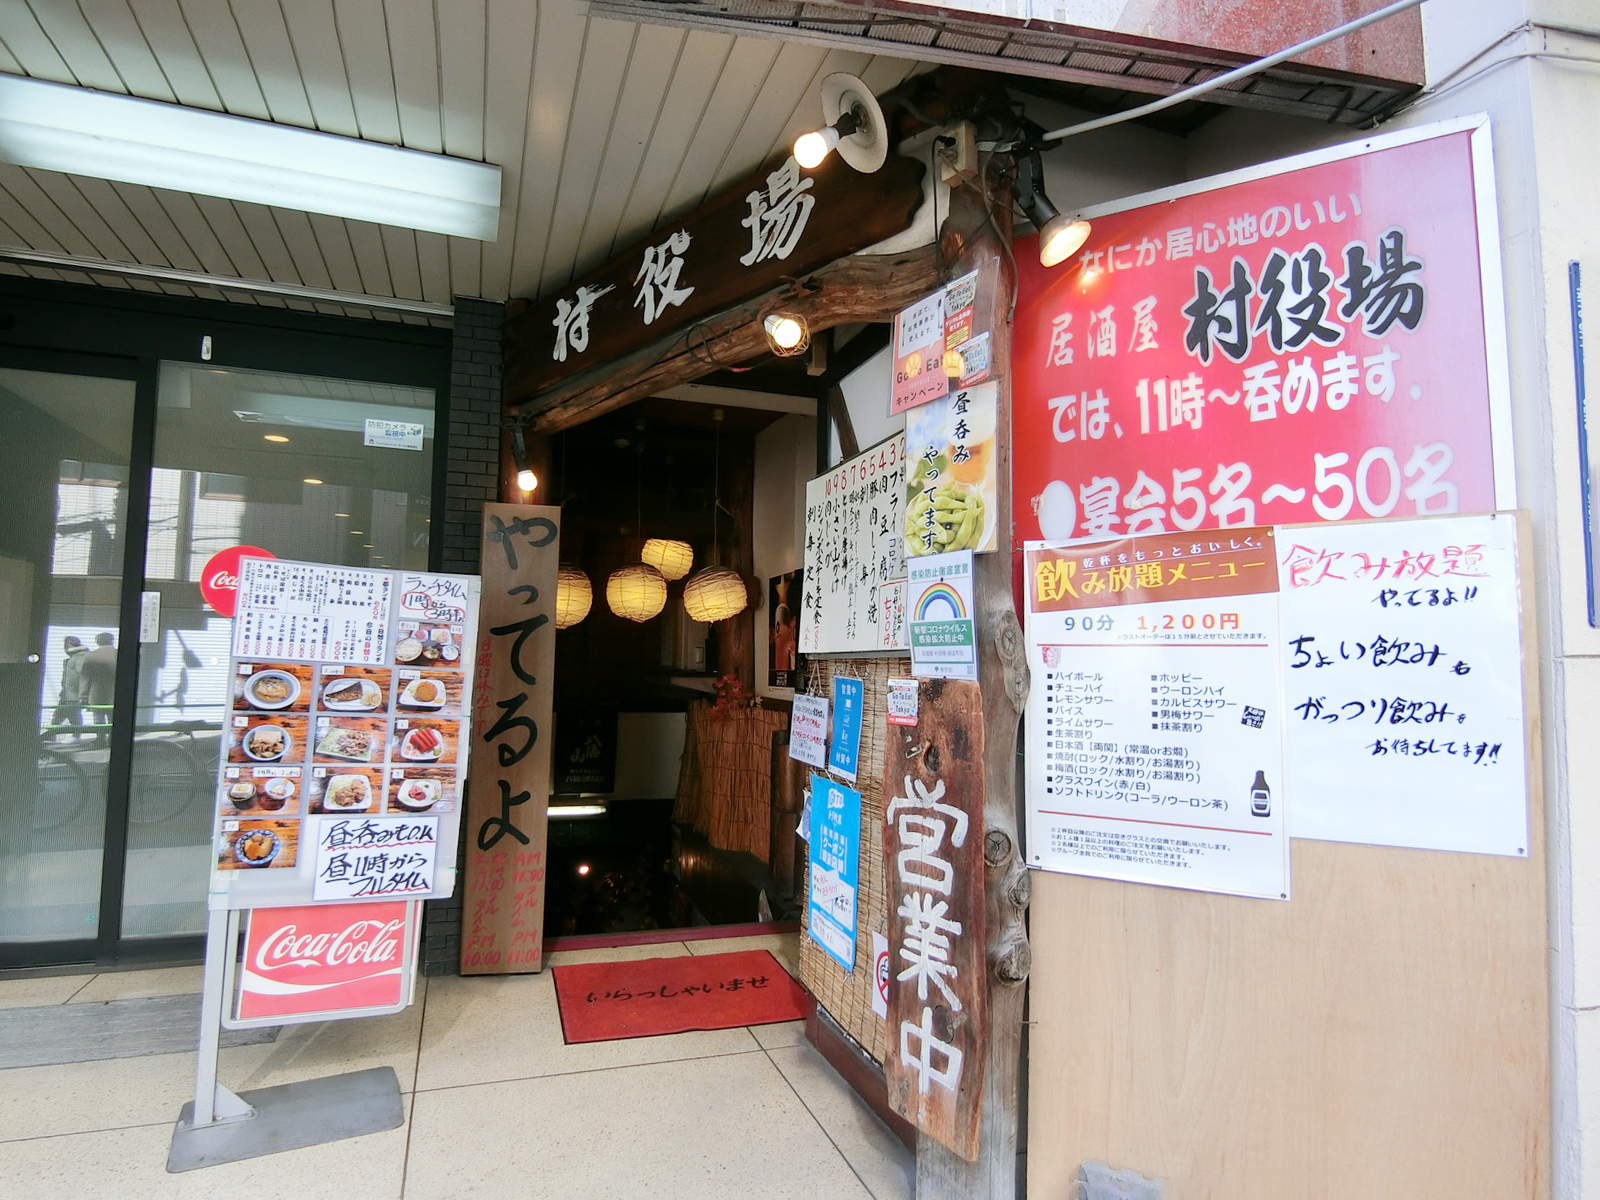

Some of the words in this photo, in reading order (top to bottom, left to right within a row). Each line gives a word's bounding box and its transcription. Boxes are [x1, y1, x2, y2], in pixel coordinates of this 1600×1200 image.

[1078, 192, 1363, 277] なにか居心地のいい
[552, 155, 816, 363] 村役場
[1045, 296, 1160, 369] 居酒屋
[1184, 227, 1425, 363] 村役場
[896, 382, 944, 406] キャンペーン
[368, 421, 406, 431] 防犯カメラ
[952, 391, 971, 465] 昼呑み
[824, 479, 831, 498] 10
[833, 474, 838, 494] 9
[841, 470, 847, 490] 8
[850, 465, 855, 485] 7
[860, 459, 866, 480] 6
[869, 454, 876, 476] 5
[879, 450, 887, 470] 4
[890, 443, 896, 466] 3
[879, 475, 889, 581] 肉豆腐
[1082, 537, 1262, 568] 乾杯をもっとおいしく。
[911, 563, 969, 580] 感染防止徹底宣言
[1282, 544, 1491, 589] 飲み放題
[405, 577, 467, 600] ランチタイム
[1034, 559, 1266, 602] 飲み放題メニュー
[403, 593, 447, 608] 11時から
[1372, 586, 1478, 608] やってるよ!!
[914, 624, 968, 634] 新型コロナウイルス
[1064, 614, 1114, 630] 90分
[1137, 613, 1241, 632] 1,200円
[1289, 634, 1471, 676] ちょい飲みも
[478, 515, 558, 851] やってるよ
[1055, 672, 1103, 682] ハイボール
[1160, 674, 1202, 683] ホッピー
[1055, 684, 1103, 693] チューハイ
[1160, 686, 1225, 696] ウーロンハイ
[895, 705, 909, 713] Tokyo
[1055, 695, 1114, 705] レモンサワー
[1160, 698, 1237, 708] カルピスサワー
[1294, 696, 1467, 725] がっつり飲みも
[1055, 706, 1084, 716] バイス
[1160, 710, 1214, 720] 男梅サワー
[1055, 718, 1114, 728] ライムサワー
[1160, 722, 1203, 733] 抹茶割り
[1055, 729, 1093, 740] 生茶割り
[1366, 738, 1503, 767] お待ちしてます!!
[1055, 774, 1151, 793] グラスワイン(赤/白)
[1055, 786, 1229, 811] ソフトドリンク(コーラ/ウーロン茶)
[823, 836, 844, 857] クーポン
[320, 852, 428, 883] 昼11時から
[348, 871, 430, 897] フルタイム
[255, 919, 405, 970] Coca-Cola
[511, 929, 537, 946] PM
[886, 774, 969, 1095] 営業中
[463, 950, 500, 967] 10:00
[506, 948, 540, 964] 11:00
[586, 975, 770, 1004] いらっしゃいませ
